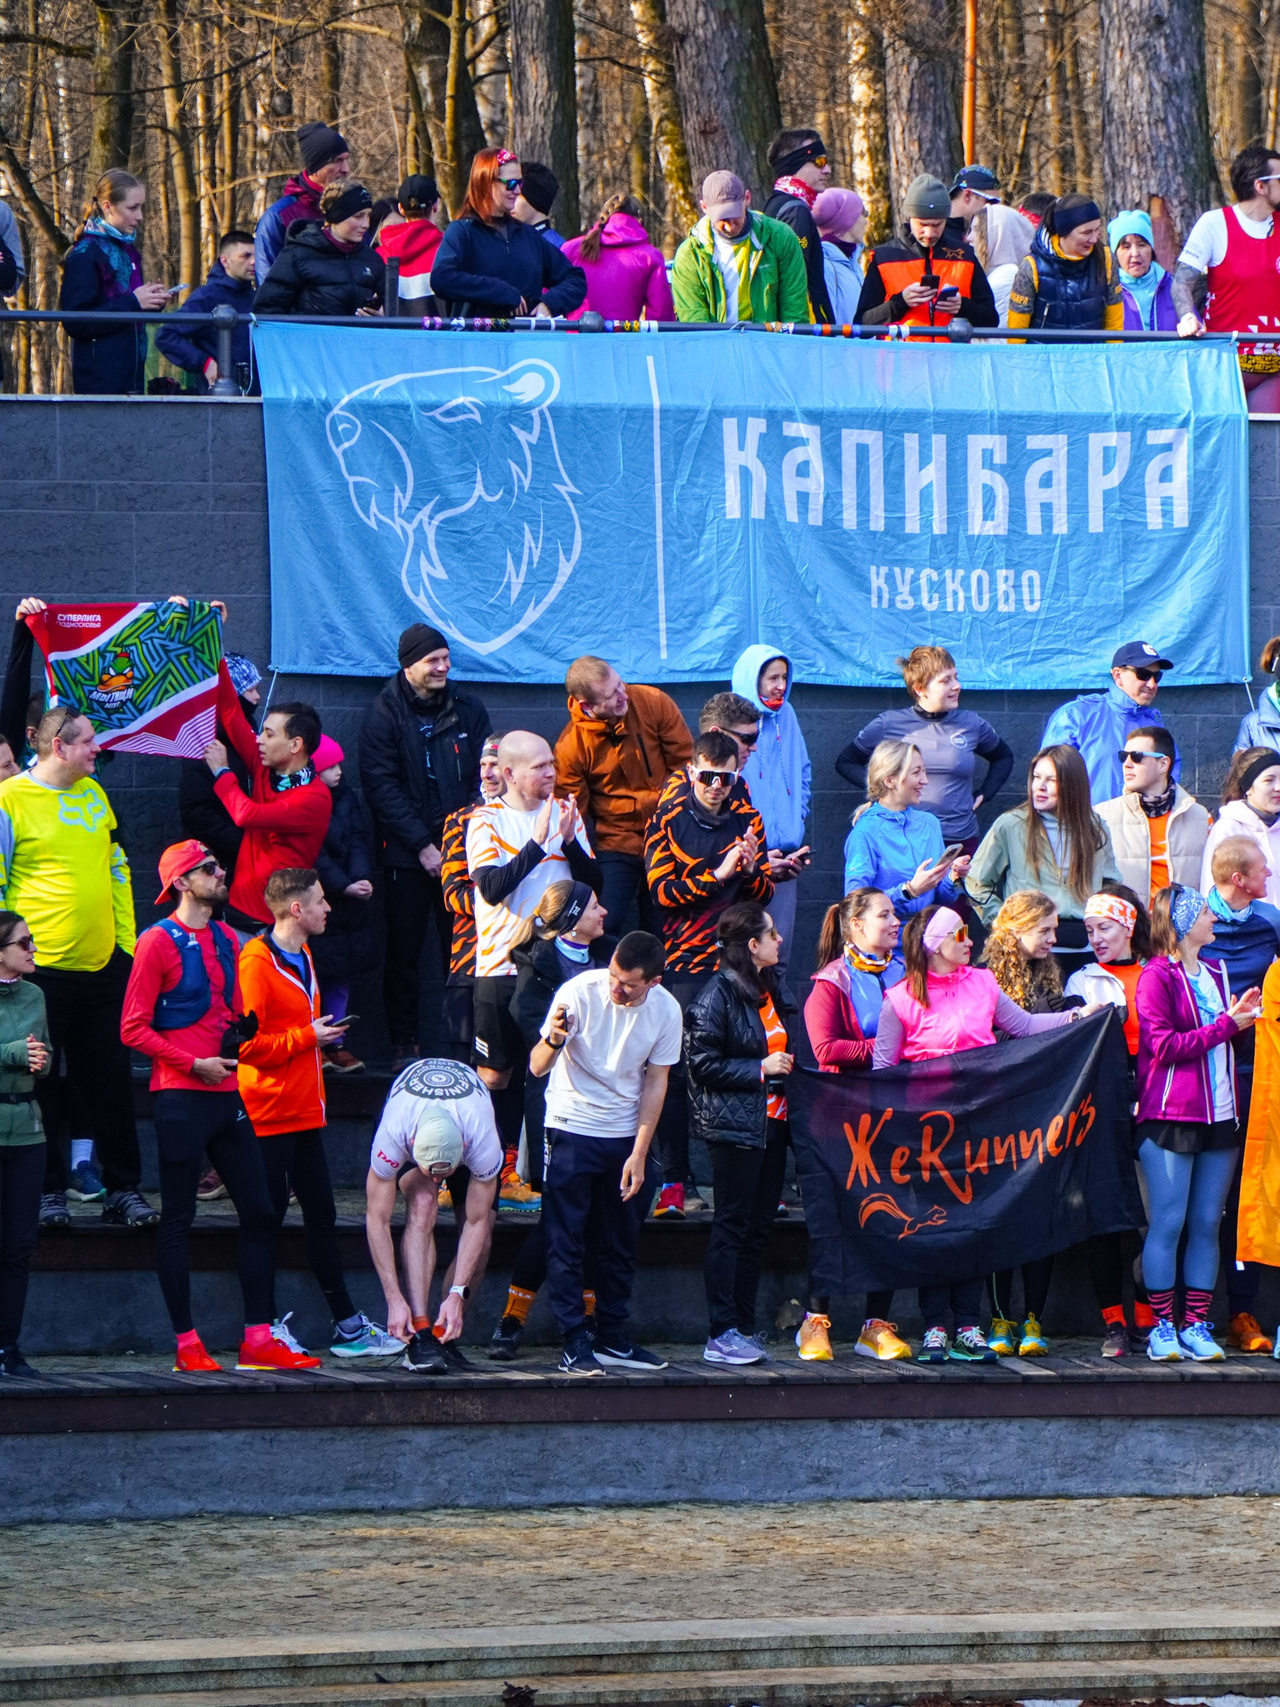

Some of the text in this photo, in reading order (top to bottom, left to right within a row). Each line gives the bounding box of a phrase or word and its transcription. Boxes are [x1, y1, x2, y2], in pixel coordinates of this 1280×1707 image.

[722, 416, 1190, 536] КАПИБАРА
[869, 565, 1041, 613] КУСКОВО
[57, 613, 102, 622] СУПЕРЛИГА
[409, 1077, 470, 1097] FINISHER
